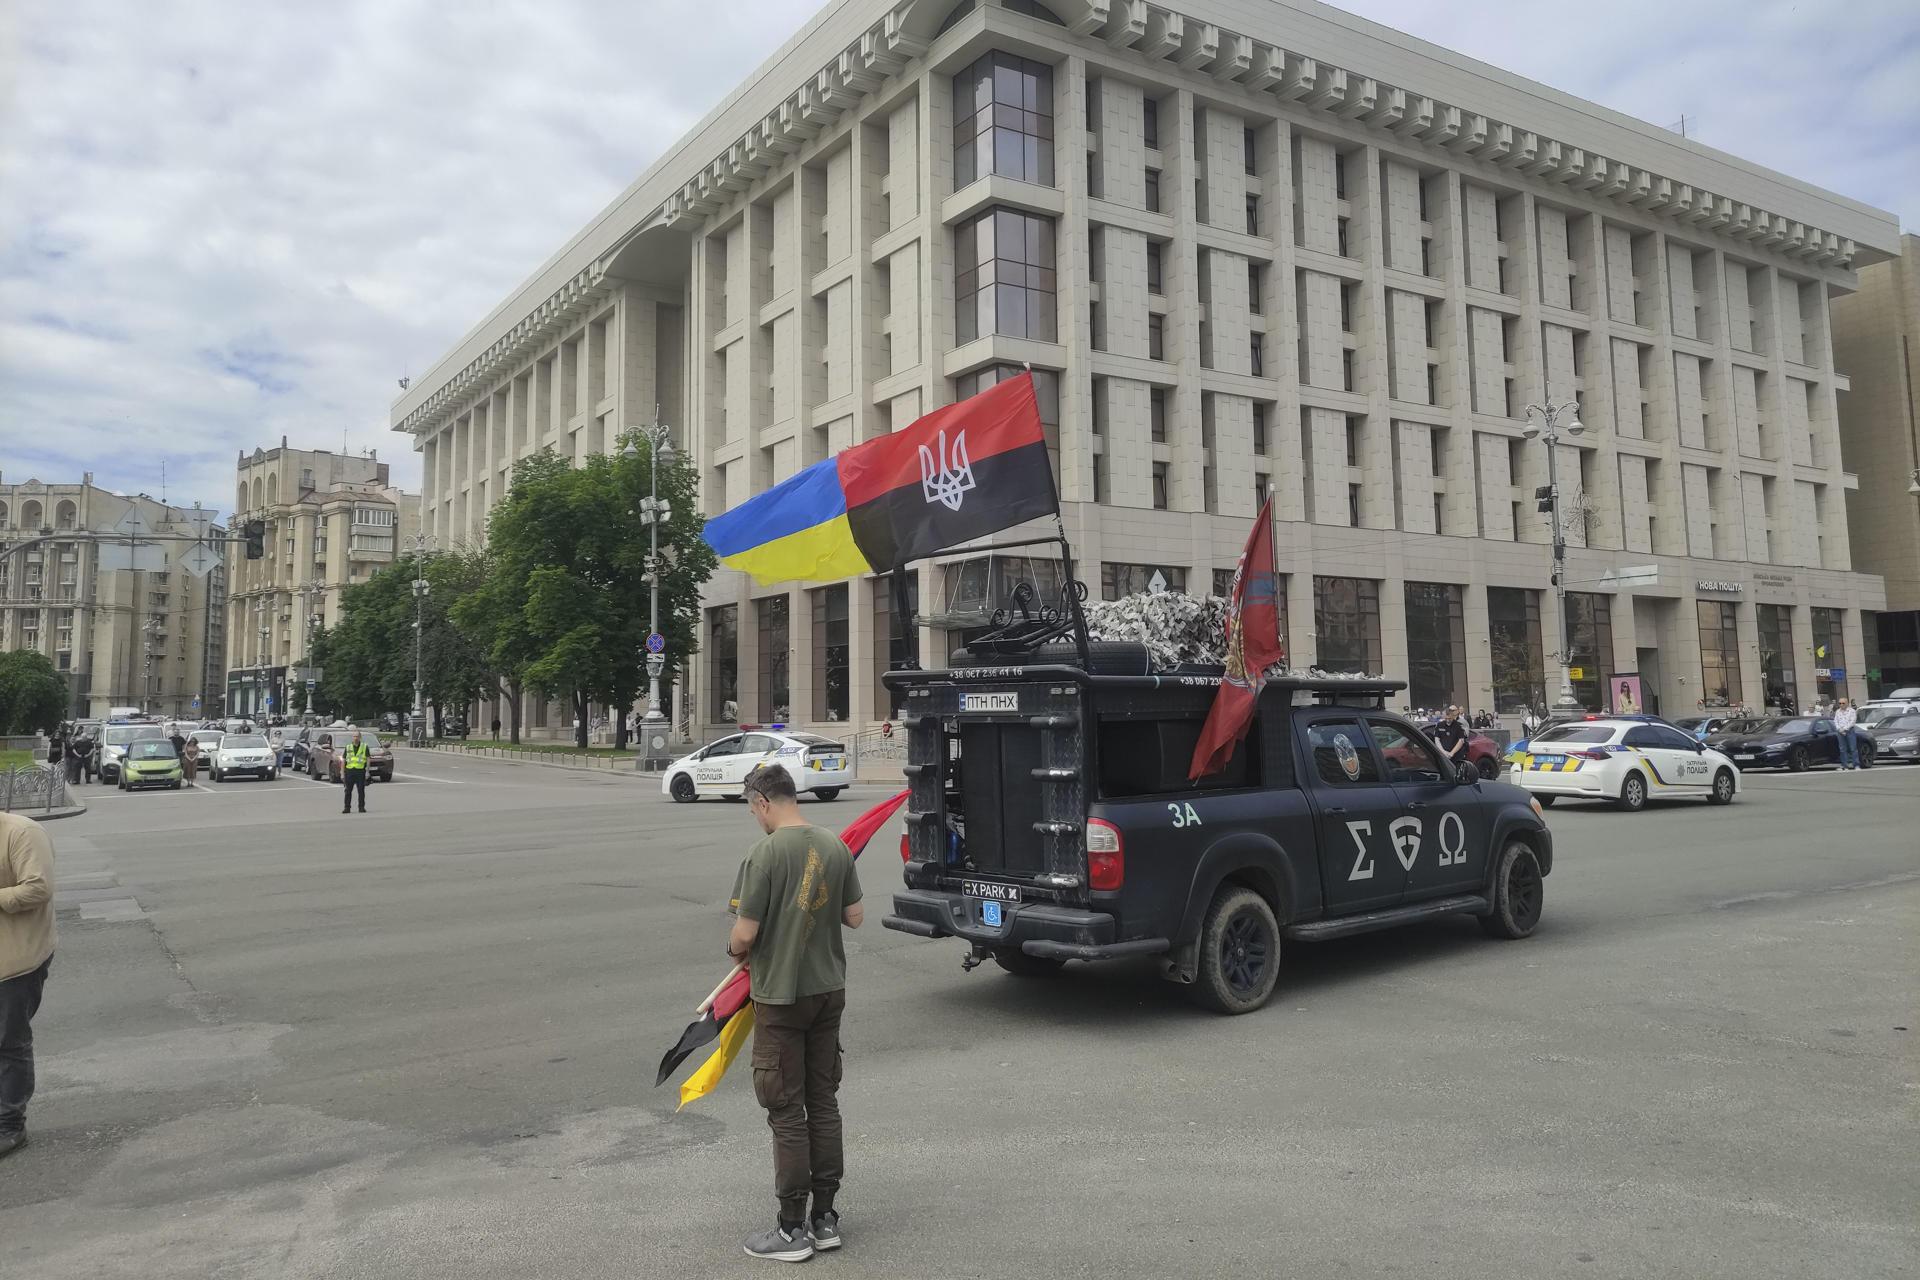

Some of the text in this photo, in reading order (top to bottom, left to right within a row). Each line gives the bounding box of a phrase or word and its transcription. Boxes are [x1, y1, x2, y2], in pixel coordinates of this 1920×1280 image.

[1699, 581, 1744, 591] НОВА ПОШТА
[949, 670, 964, 679] +38
[1180, 676, 1194, 685] +38
[967, 695, 1015, 708] ПТН ПНХ
[1686, 766, 1708, 774] ПОЛІЦІЯ
[696, 773, 723, 781] ПОЛІЦІЯ
[971, 883, 1006, 899] X PARK
